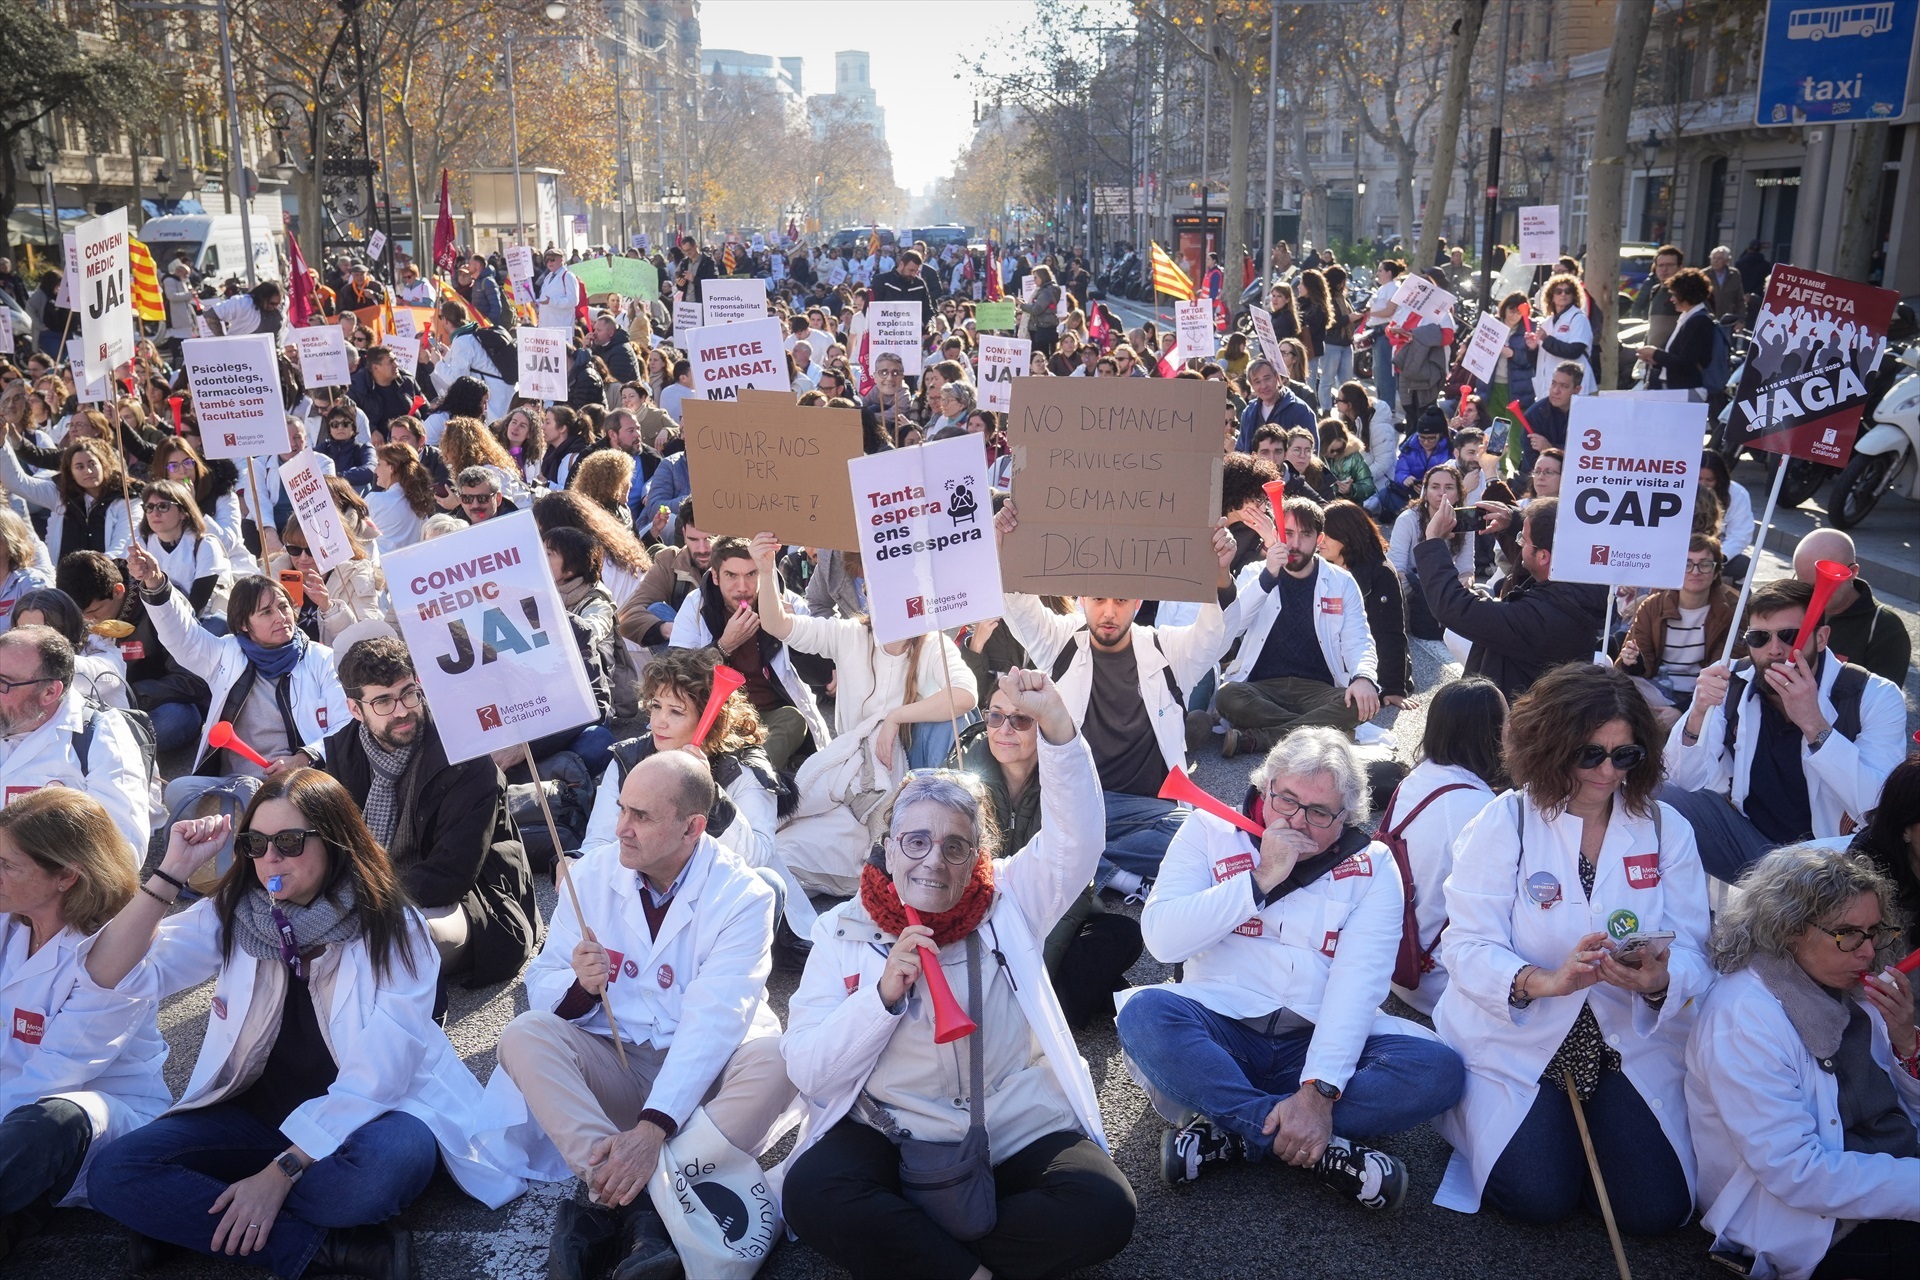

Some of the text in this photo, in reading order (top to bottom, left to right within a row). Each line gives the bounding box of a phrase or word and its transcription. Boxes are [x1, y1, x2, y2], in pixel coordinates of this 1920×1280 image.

[1803, 73, 1862, 101] taxi
[85, 232, 122, 259] CONVENI
[86, 254, 114, 278] MÈDIC
[1787, 274, 1797, 282] TU
[1799, 278, 1826, 289] TAMBÉ
[89, 268, 124, 320] JA!
[1776, 283, 1855, 314] T'AFECTA
[876, 320, 914, 328] explotats
[881, 310, 910, 318] Metges
[524, 337, 558, 346] CONVENI
[700, 341, 762, 362] METGE
[985, 346, 1022, 356] CONVENI
[192, 363, 252, 374] Psicòlegs,
[526, 355, 559, 373] JA!
[704, 359, 777, 382] CANSAT,
[194, 374, 263, 386] odontòlegs,
[1790, 372, 1814, 384] GENER
[197, 385, 273, 397] farmacòlegs,
[1738, 367, 1867, 430] VAGA
[200, 398, 264, 409] també som
[202, 409, 264, 421] facultatius
[1024, 405, 1193, 432] NO DEMANEM
[698, 426, 820, 458] CUIDAR-NOS
[1582, 429, 1601, 450] 3
[1813, 441, 1832, 451] Metges
[1050, 449, 1162, 470] PRIVILEGIS
[1811, 448, 1839, 459] Catalunya
[745, 459, 778, 480] PER
[1578, 456, 1686, 474] SETMANES
[288, 468, 312, 490] METGE
[1576, 475, 1684, 488] per tenir visita al
[294, 479, 322, 502] CANSAT,
[713, 489, 800, 512] CUIDAR-TE
[868, 486, 925, 508] Tanta
[1046, 487, 1175, 513] DEMANEM
[871, 501, 941, 526] espera
[1574, 488, 1682, 527] CAP
[874, 526, 910, 543] ens
[876, 528, 982, 561] desespera
[1610, 559, 1650, 569] Catalunya
[1611, 550, 1640, 560] Metges
[410, 547, 521, 595] CONVENI
[417, 581, 500, 621] MÈDIC
[926, 595, 956, 606] Metges
[928, 600, 968, 615] Catalunya
[436, 596, 550, 674] JA!
[500, 695, 547, 715] Metges de
[504, 706, 550, 725] Catalunya
[685, 1158, 716, 1177] de
